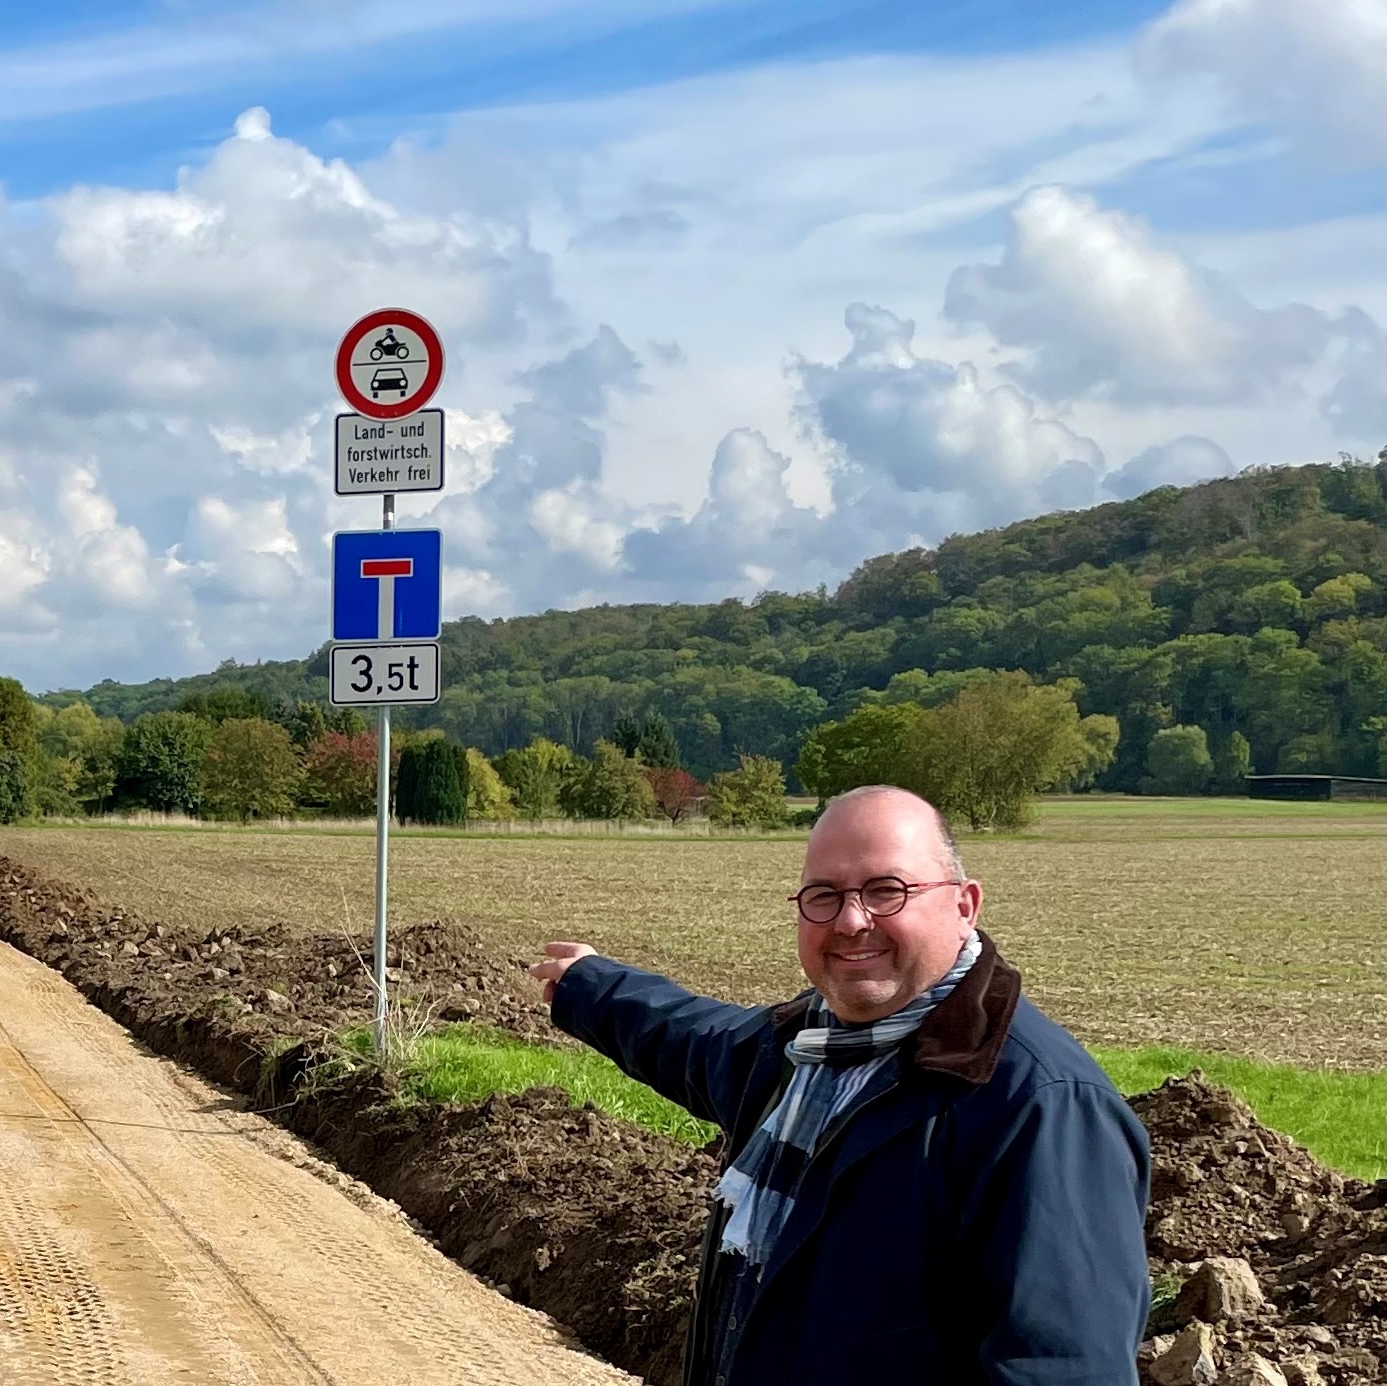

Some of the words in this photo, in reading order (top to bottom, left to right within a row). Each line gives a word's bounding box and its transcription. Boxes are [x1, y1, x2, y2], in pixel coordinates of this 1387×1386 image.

[354, 423, 394, 440] Land-
[400, 421, 425, 438] und
[347, 443, 432, 462] forstwirtsch.
[348, 466, 400, 484] Verkehr
[408, 464, 431, 481] frei
